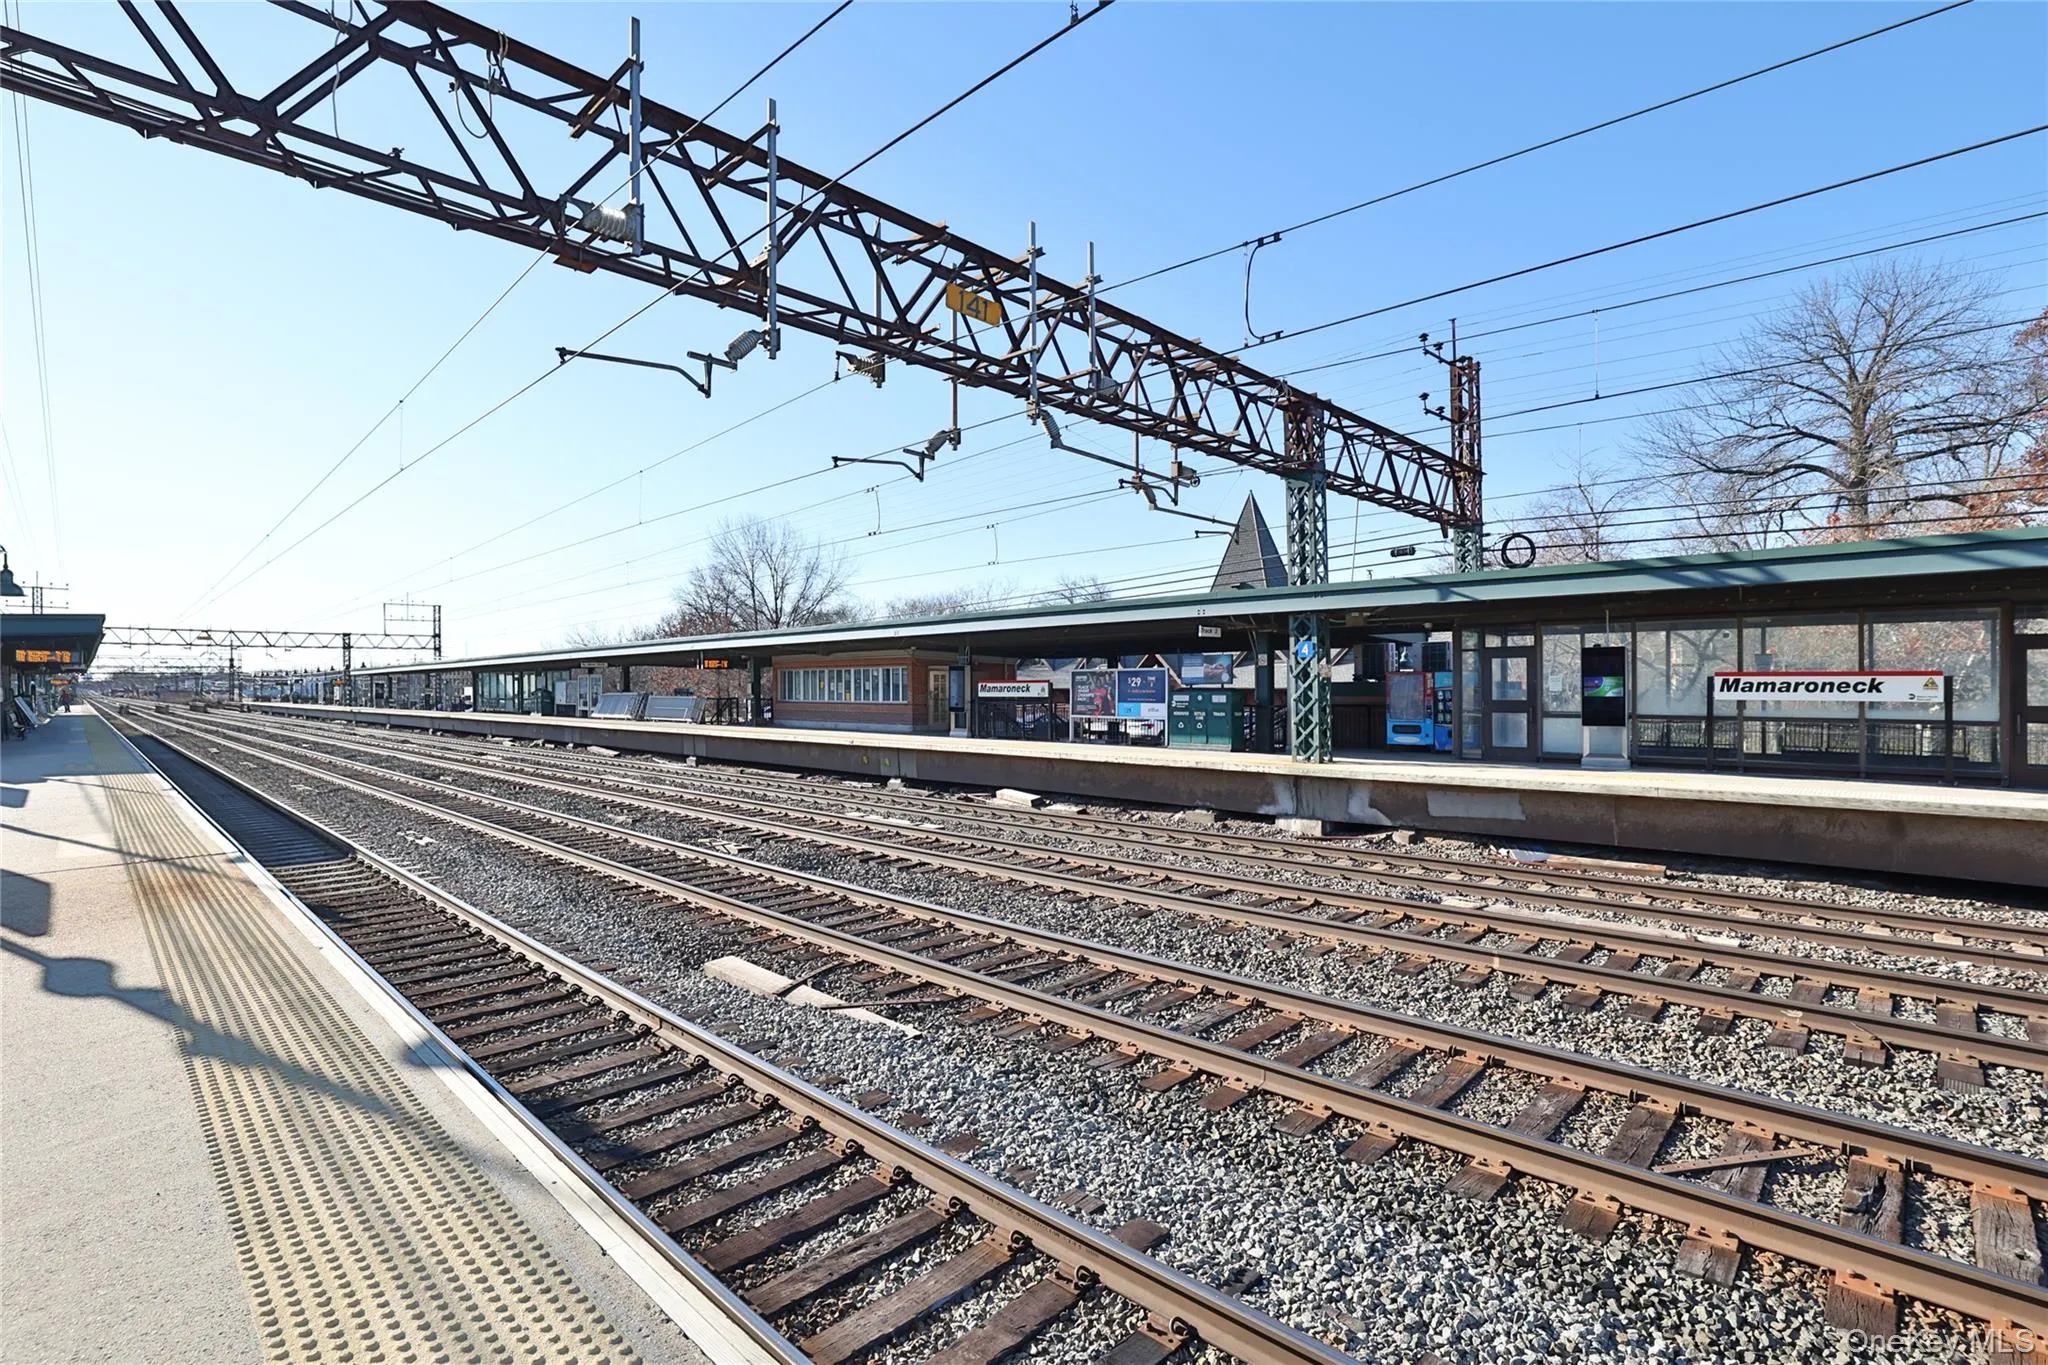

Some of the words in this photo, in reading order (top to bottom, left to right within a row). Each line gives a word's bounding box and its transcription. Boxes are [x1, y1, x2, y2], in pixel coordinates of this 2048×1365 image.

[958, 290, 988, 322] 141
[1301, 642, 1309, 656] 4
[980, 683, 1031, 693] Mamaroneck
[1719, 678, 1885, 694] Mamaroneck
